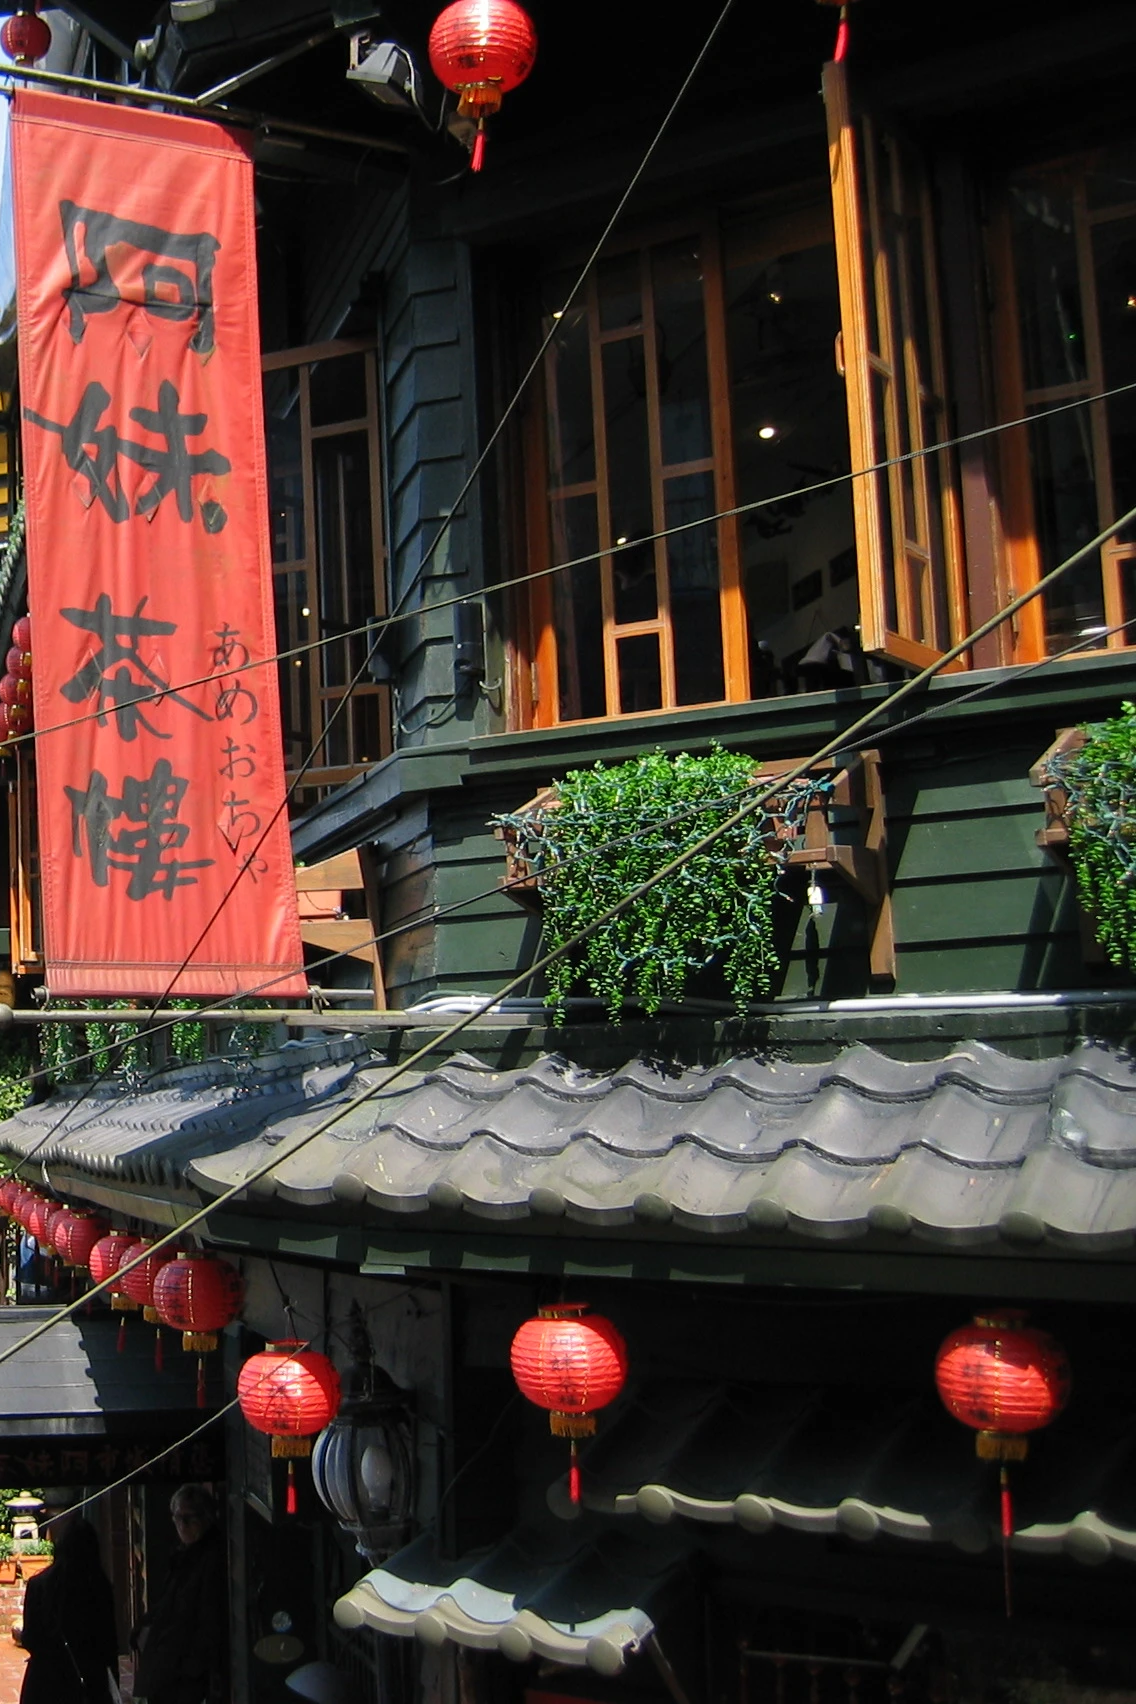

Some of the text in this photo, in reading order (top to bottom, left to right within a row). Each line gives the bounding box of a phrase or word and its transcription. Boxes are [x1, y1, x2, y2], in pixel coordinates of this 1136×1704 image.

[23, 199, 232, 901] 阿妹茶樓
[211, 621, 269, 885] あめおちゃ
